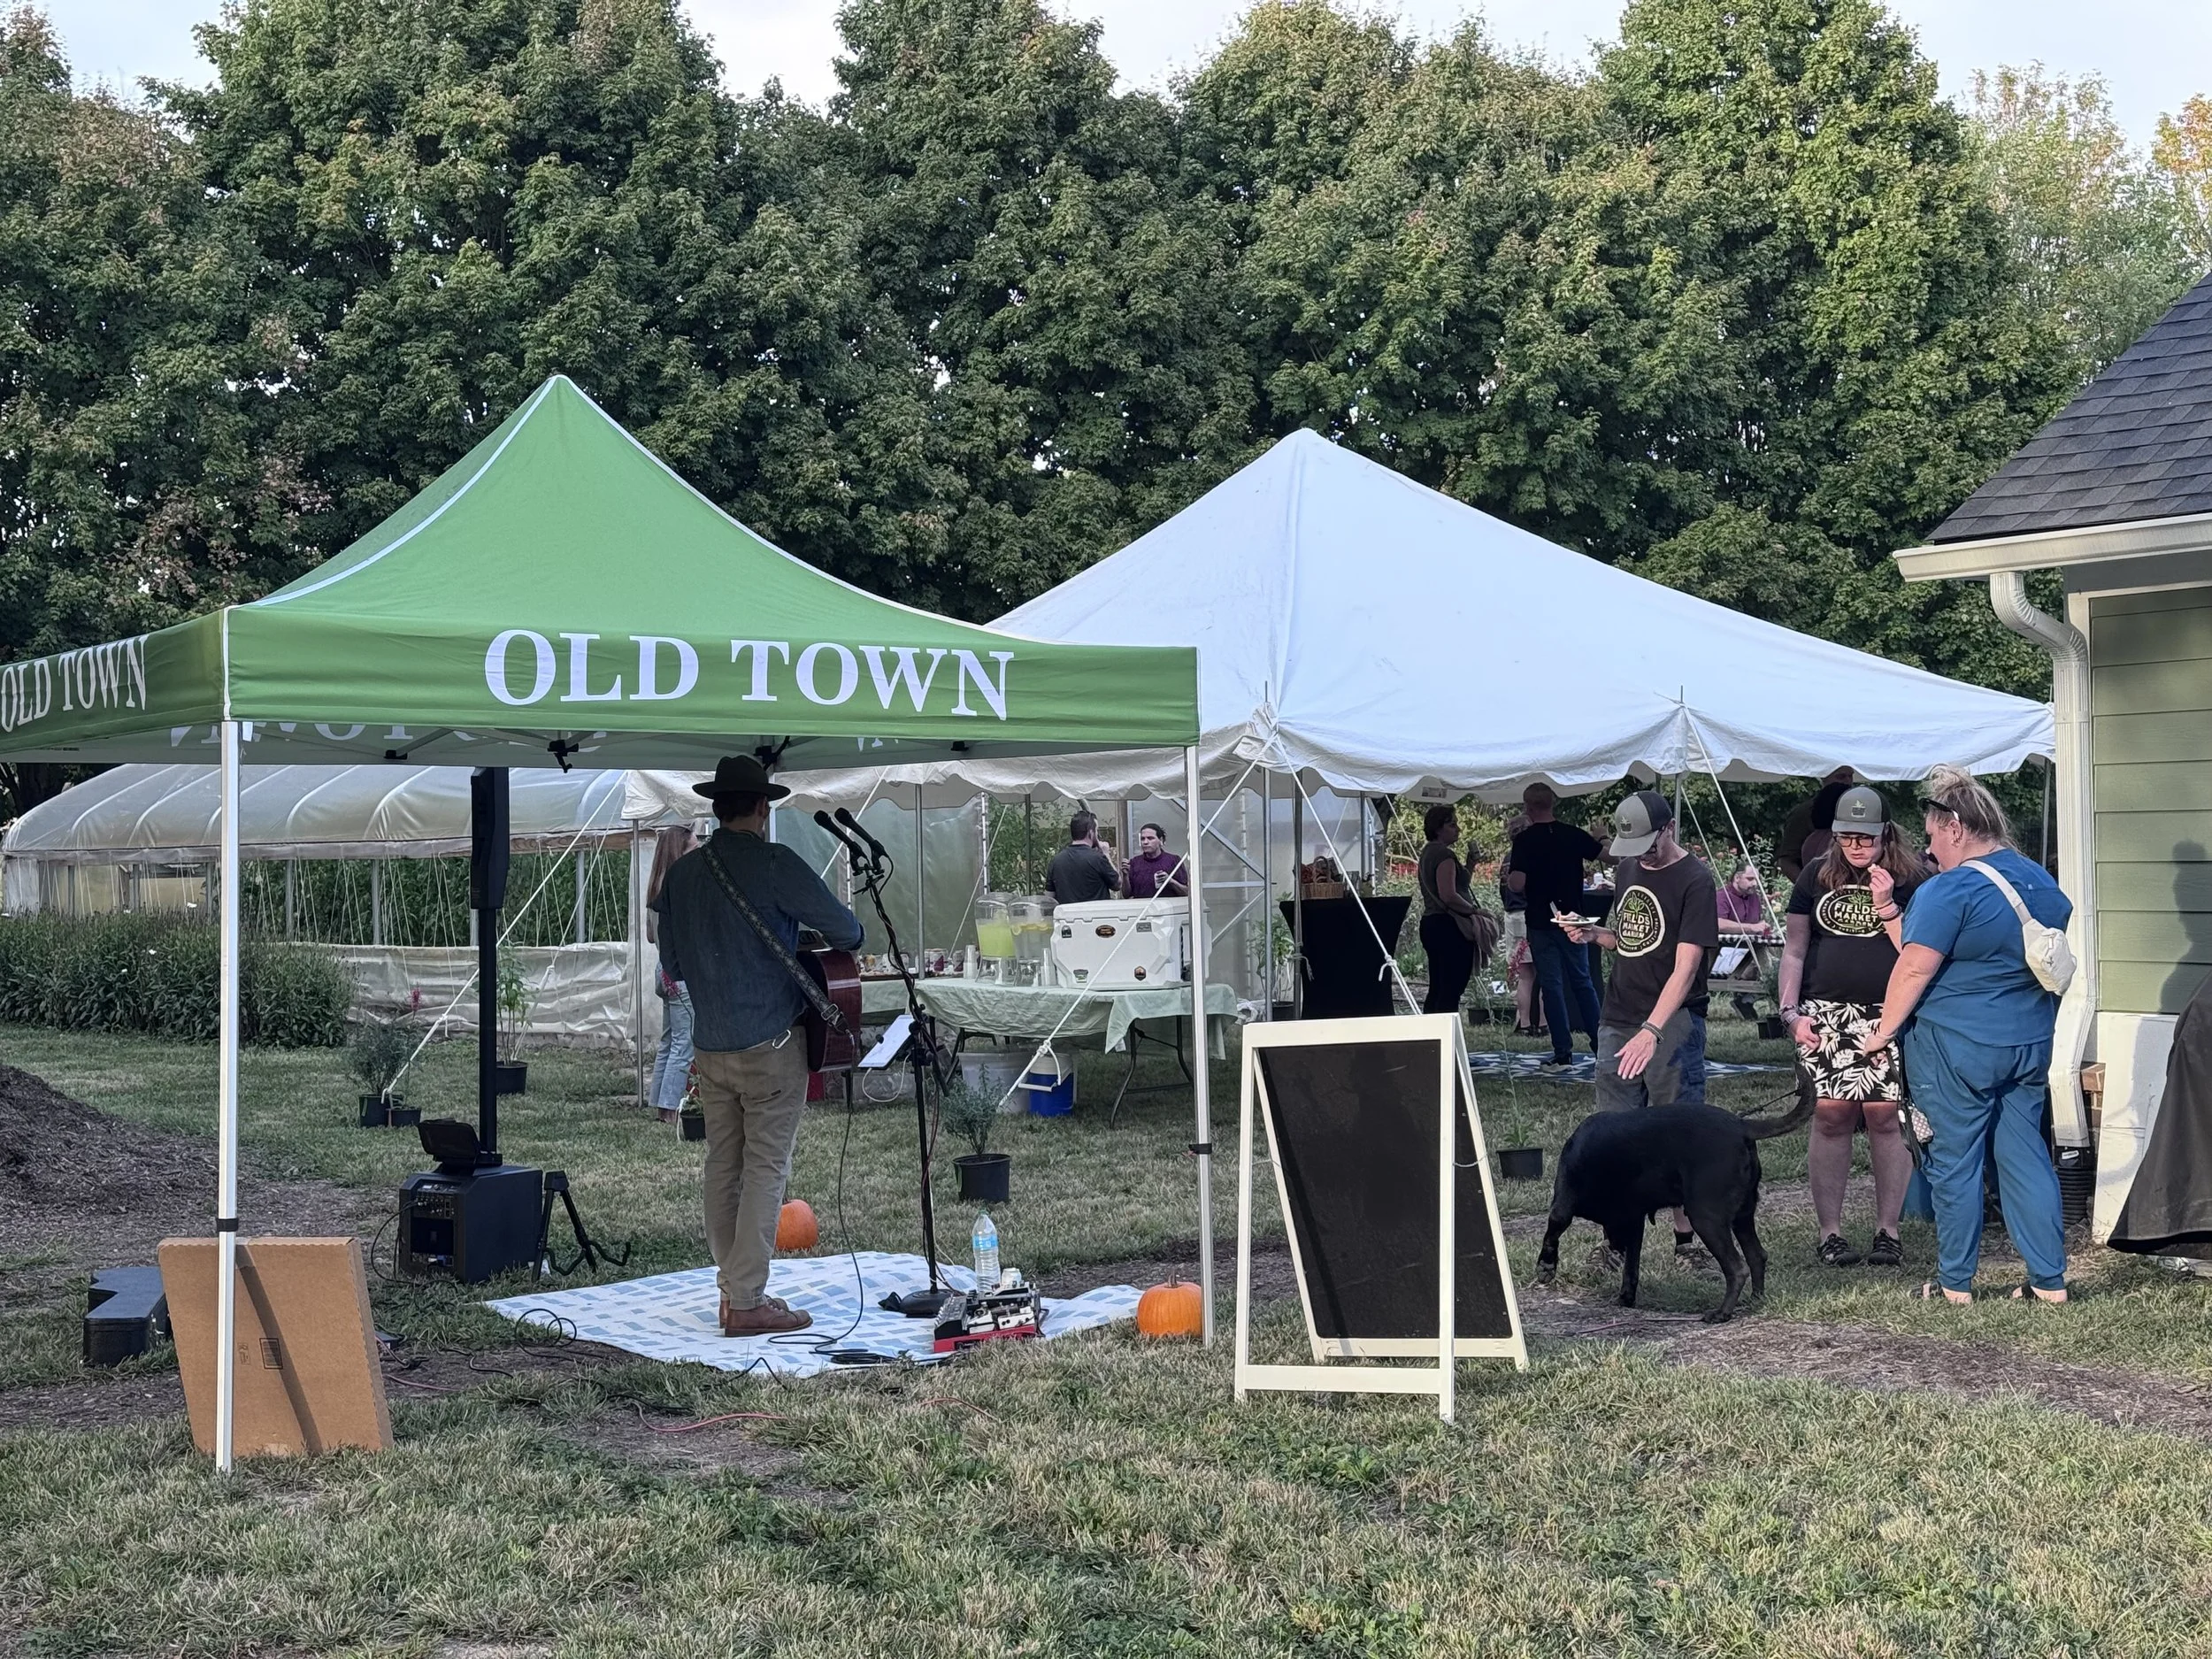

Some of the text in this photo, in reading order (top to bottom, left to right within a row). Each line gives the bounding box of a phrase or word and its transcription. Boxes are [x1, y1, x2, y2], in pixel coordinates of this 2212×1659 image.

[1, 634, 150, 733] OLD TOWN
[484, 629, 1015, 721] OLD TOWN
[1834, 902, 1878, 915] FIELDS
[1834, 910, 1878, 923] MARKET
